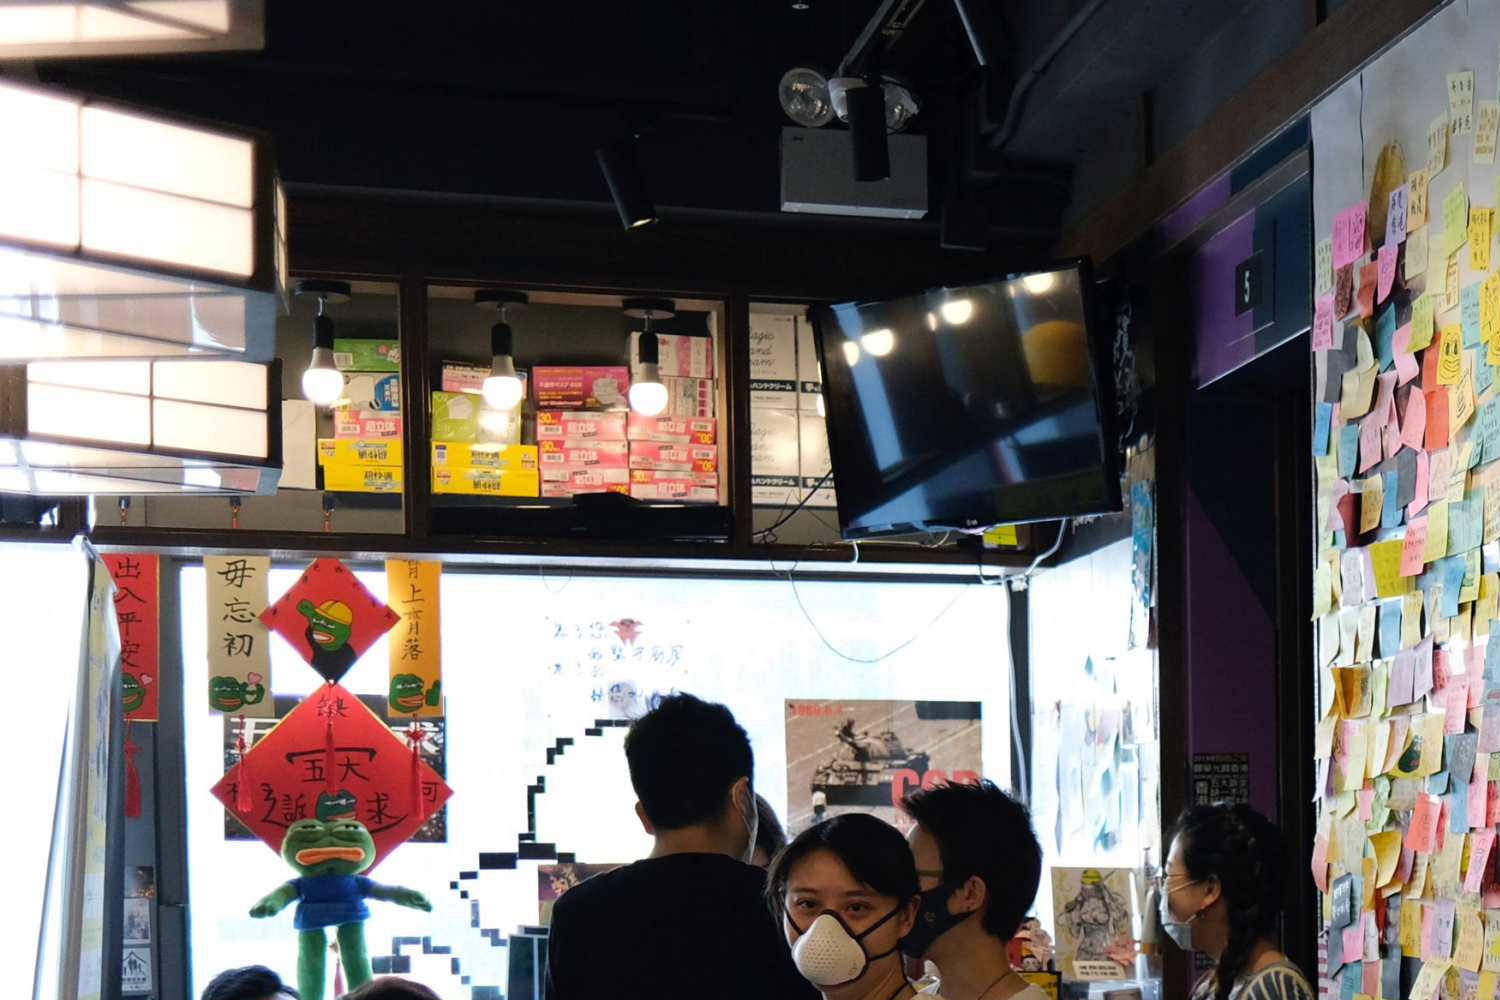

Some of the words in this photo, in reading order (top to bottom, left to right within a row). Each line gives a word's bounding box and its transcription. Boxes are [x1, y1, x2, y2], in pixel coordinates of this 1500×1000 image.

[750, 328, 774, 344] agic
[750, 345, 772, 355] and
[751, 422, 775, 438] agic
[752, 443, 772, 451] and
[113, 556, 148, 669] 出入平安
[217, 559, 258, 657] 毋忘初
